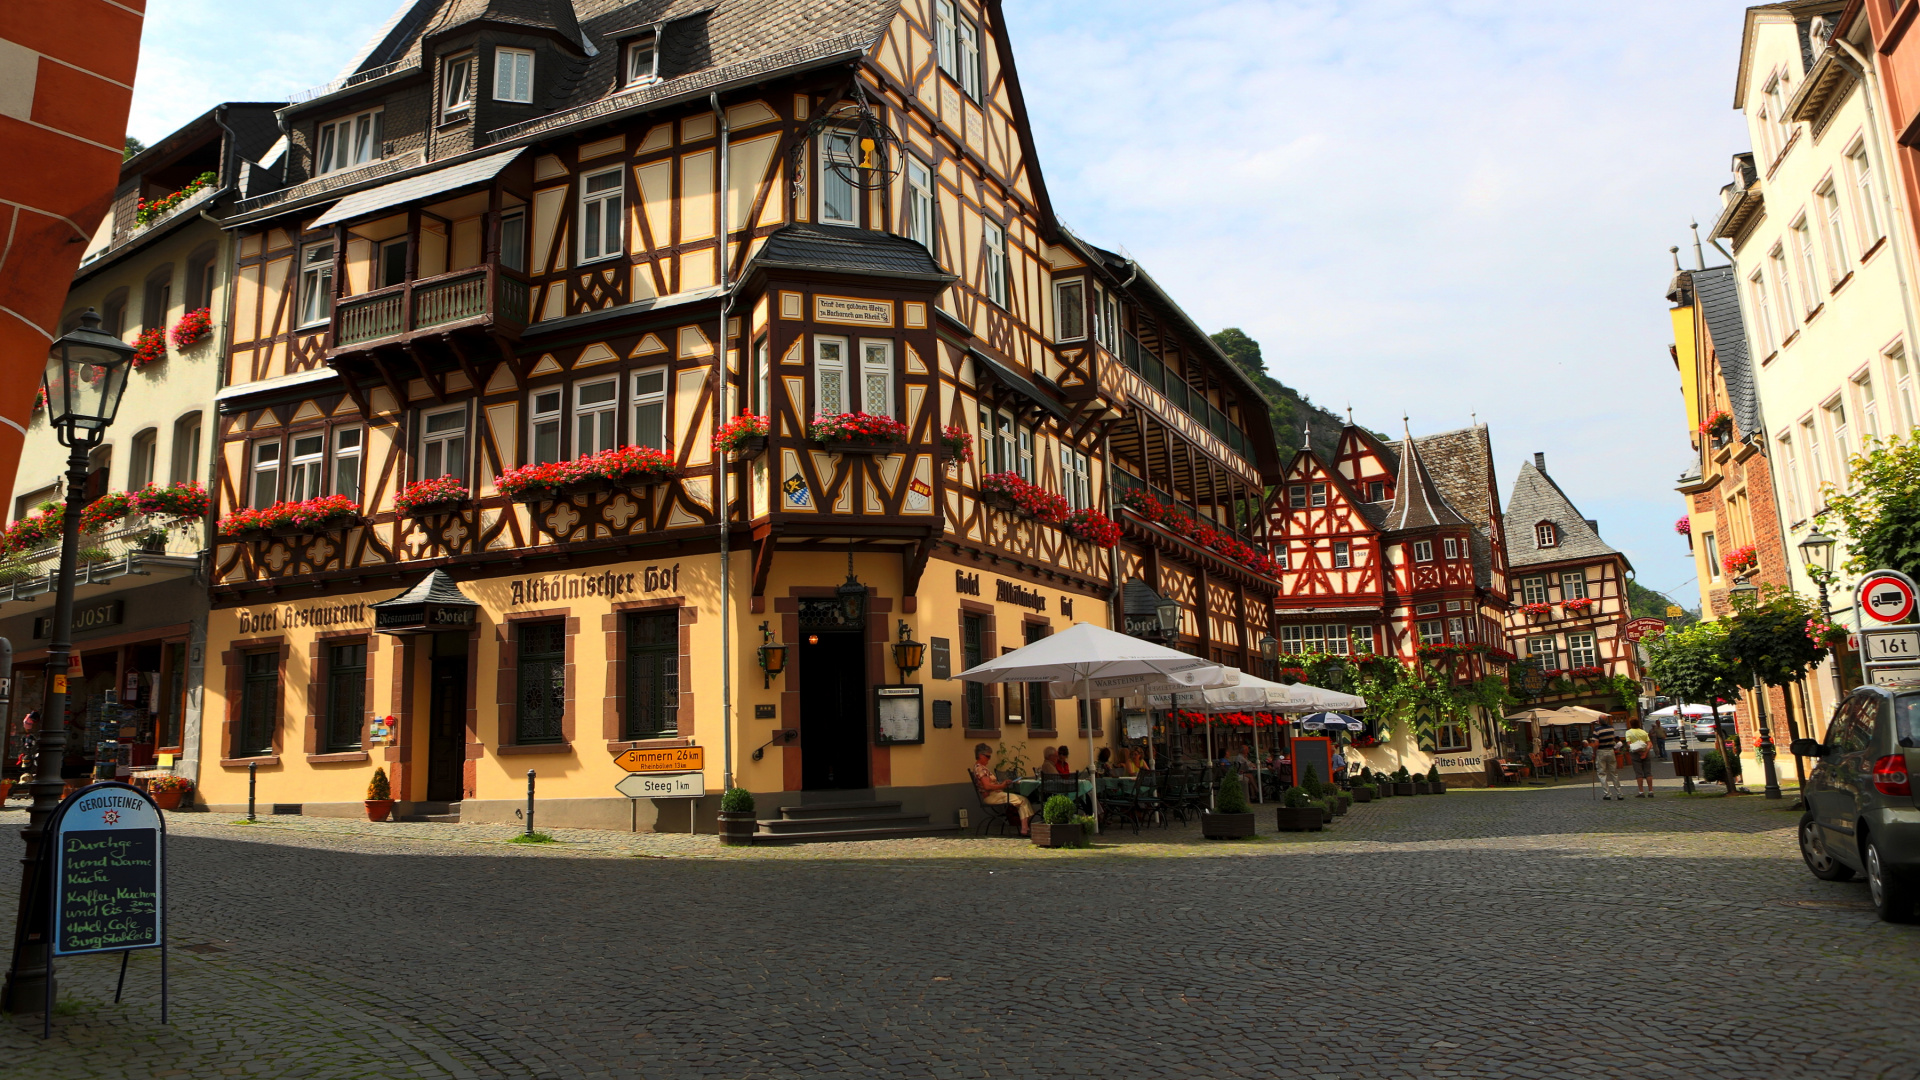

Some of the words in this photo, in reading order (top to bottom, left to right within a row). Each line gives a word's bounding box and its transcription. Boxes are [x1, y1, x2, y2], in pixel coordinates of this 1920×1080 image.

[511, 570, 634, 606] Altkölnischer
[644, 562, 680, 593] Hof
[955, 569, 980, 596] Hotel
[1060, 595, 1073, 621] Hof
[240, 608, 278, 634] Hotel
[282, 600, 366, 631] Restaurant
[379, 612, 424, 625] Restaurant
[435, 608, 468, 625] Hotel
[1124, 616, 1158, 634] Hotel
[1095, 676, 1145, 688] WARSTEINER
[629, 752, 672, 762] Simmern
[1434, 756, 1456, 767] Altes
[1458, 756, 1481, 767] Haus
[644, 780, 672, 793] Steeg
[79, 796, 143, 812] GEROLSTEINER
[67, 856, 108, 869] hend
[111, 858, 152, 867] warme
[67, 870, 111, 884] Küche
[116, 887, 156, 899] Kuchen
[66, 905, 98, 918] und
[101, 903, 123, 916] Eis
